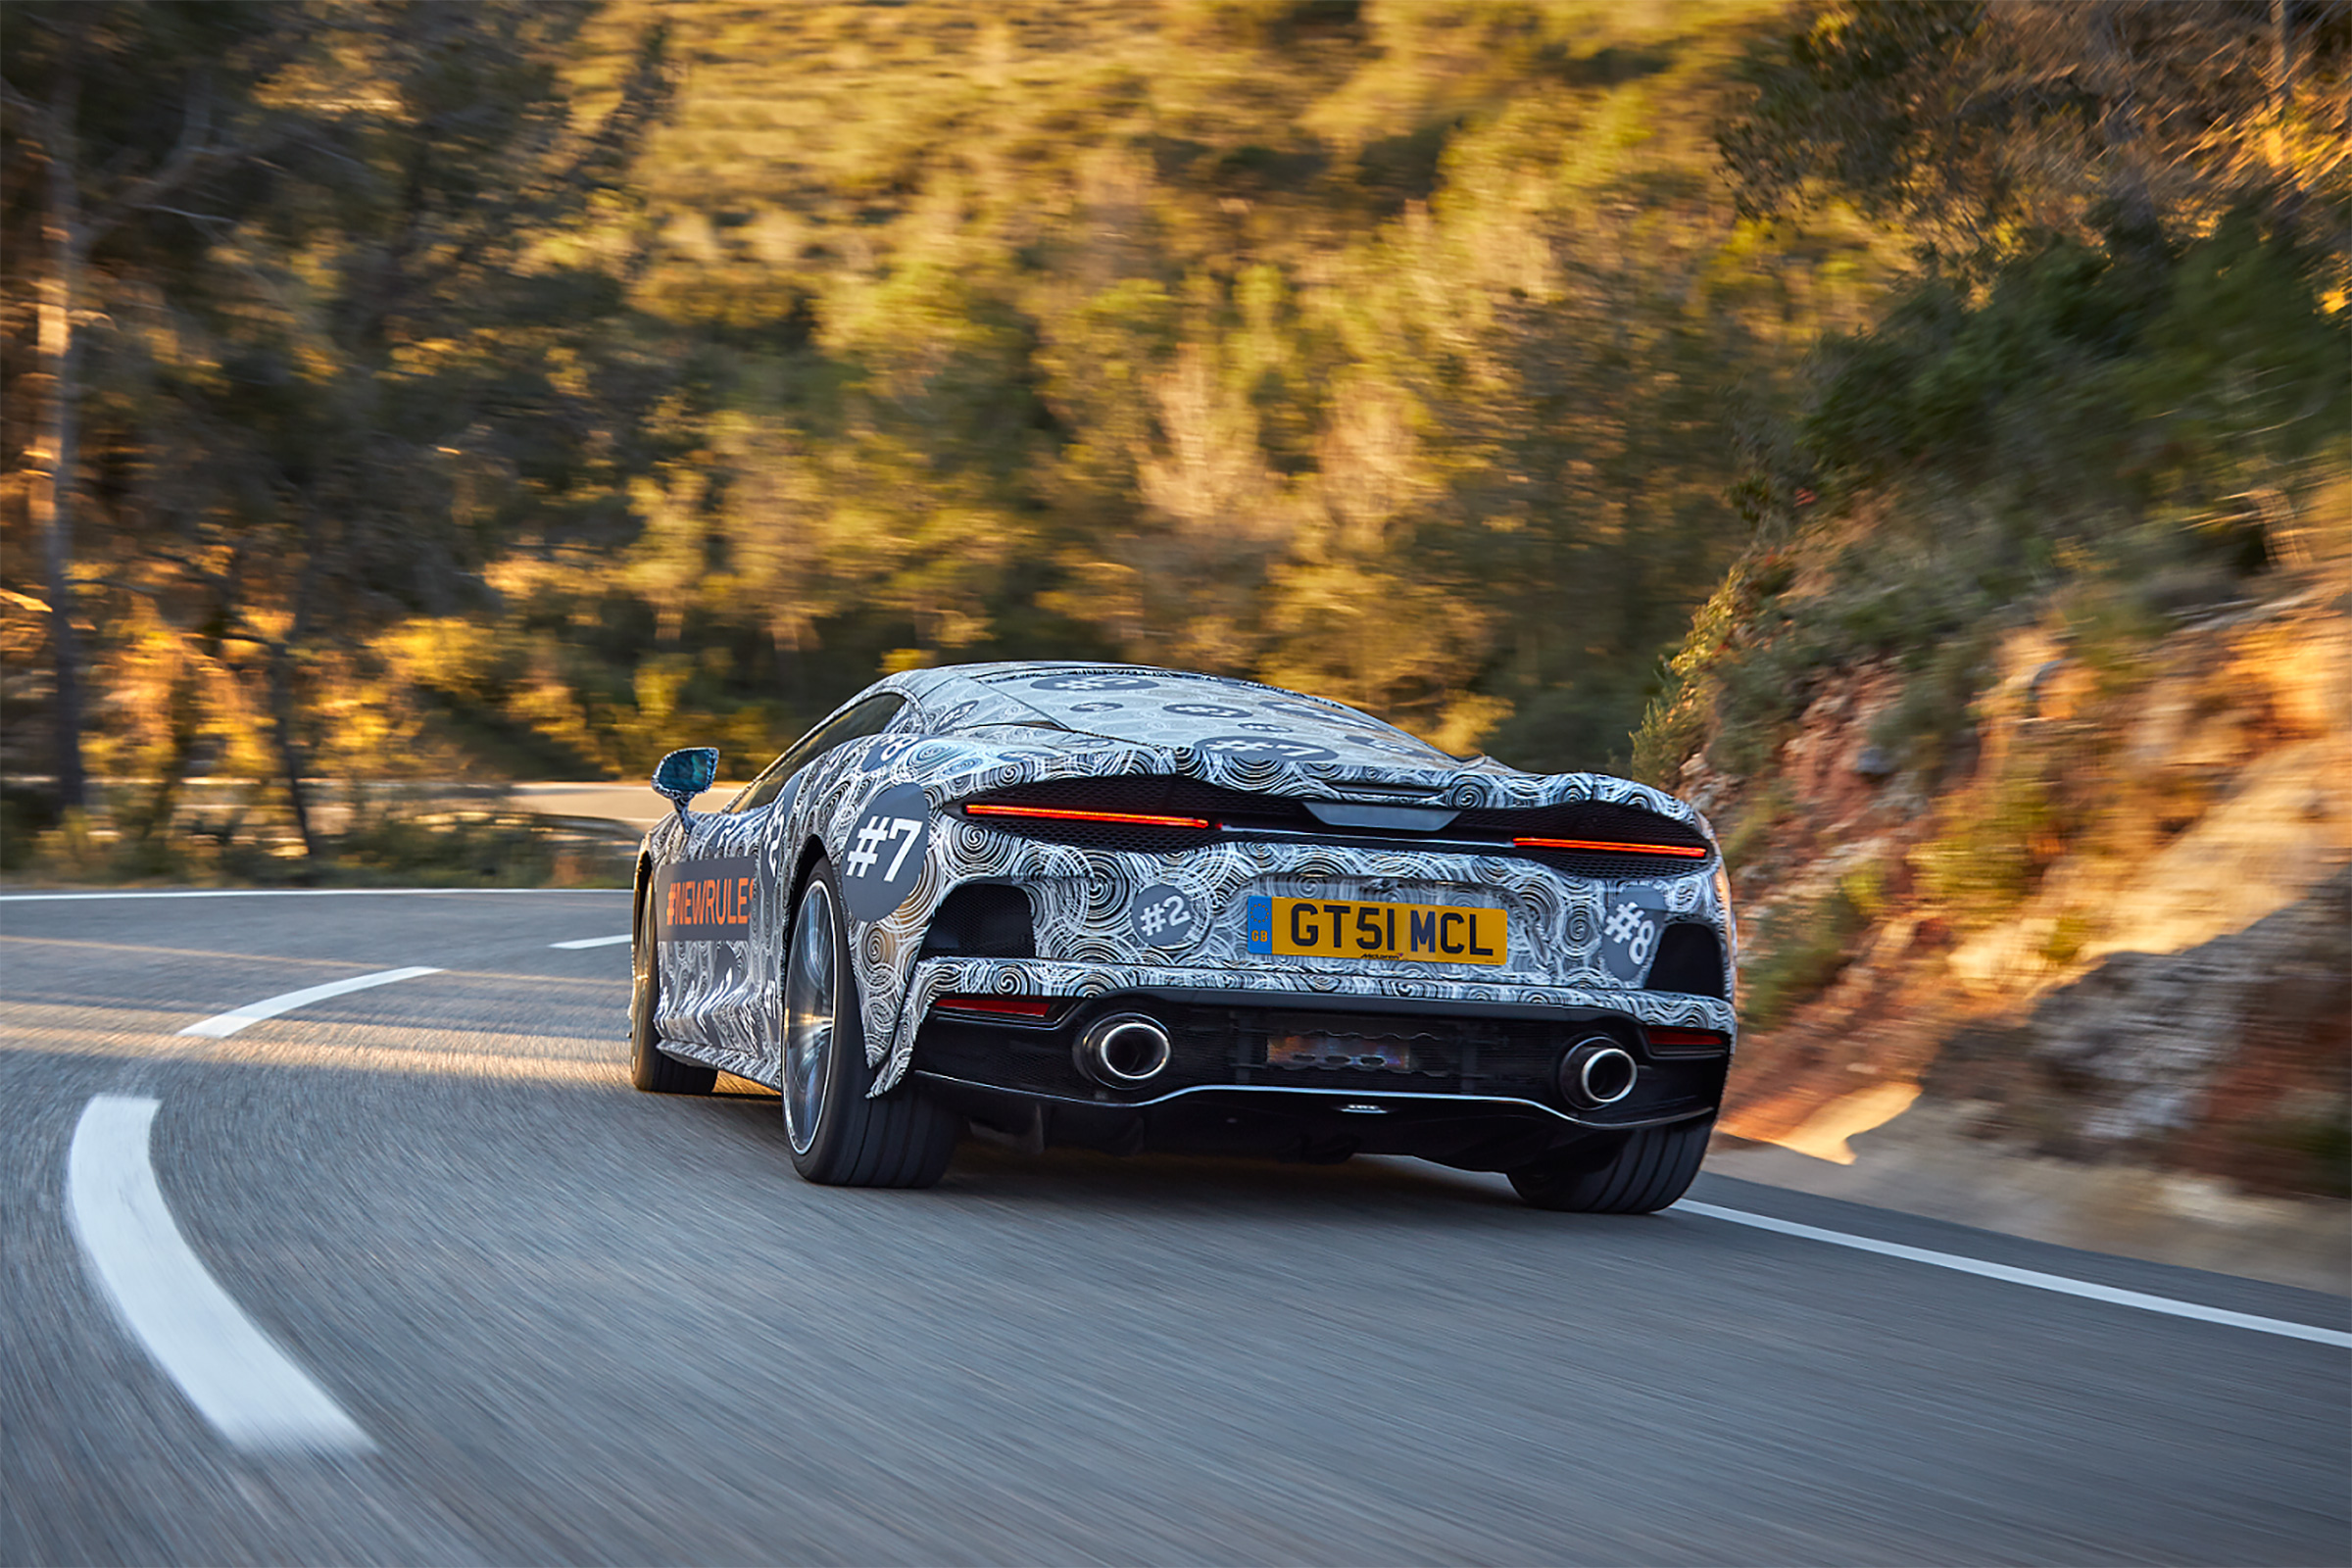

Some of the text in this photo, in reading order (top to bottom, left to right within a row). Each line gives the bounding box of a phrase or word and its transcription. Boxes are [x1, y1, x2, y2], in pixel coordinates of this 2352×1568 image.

[1204, 740, 1325, 758] #7
[846, 815, 923, 882] #7
[1140, 895, 1192, 937] #2
[1251, 930, 1268, 943] GB
[1410, 909, 1494, 956] MCL
[1603, 902, 1655, 965] #8
